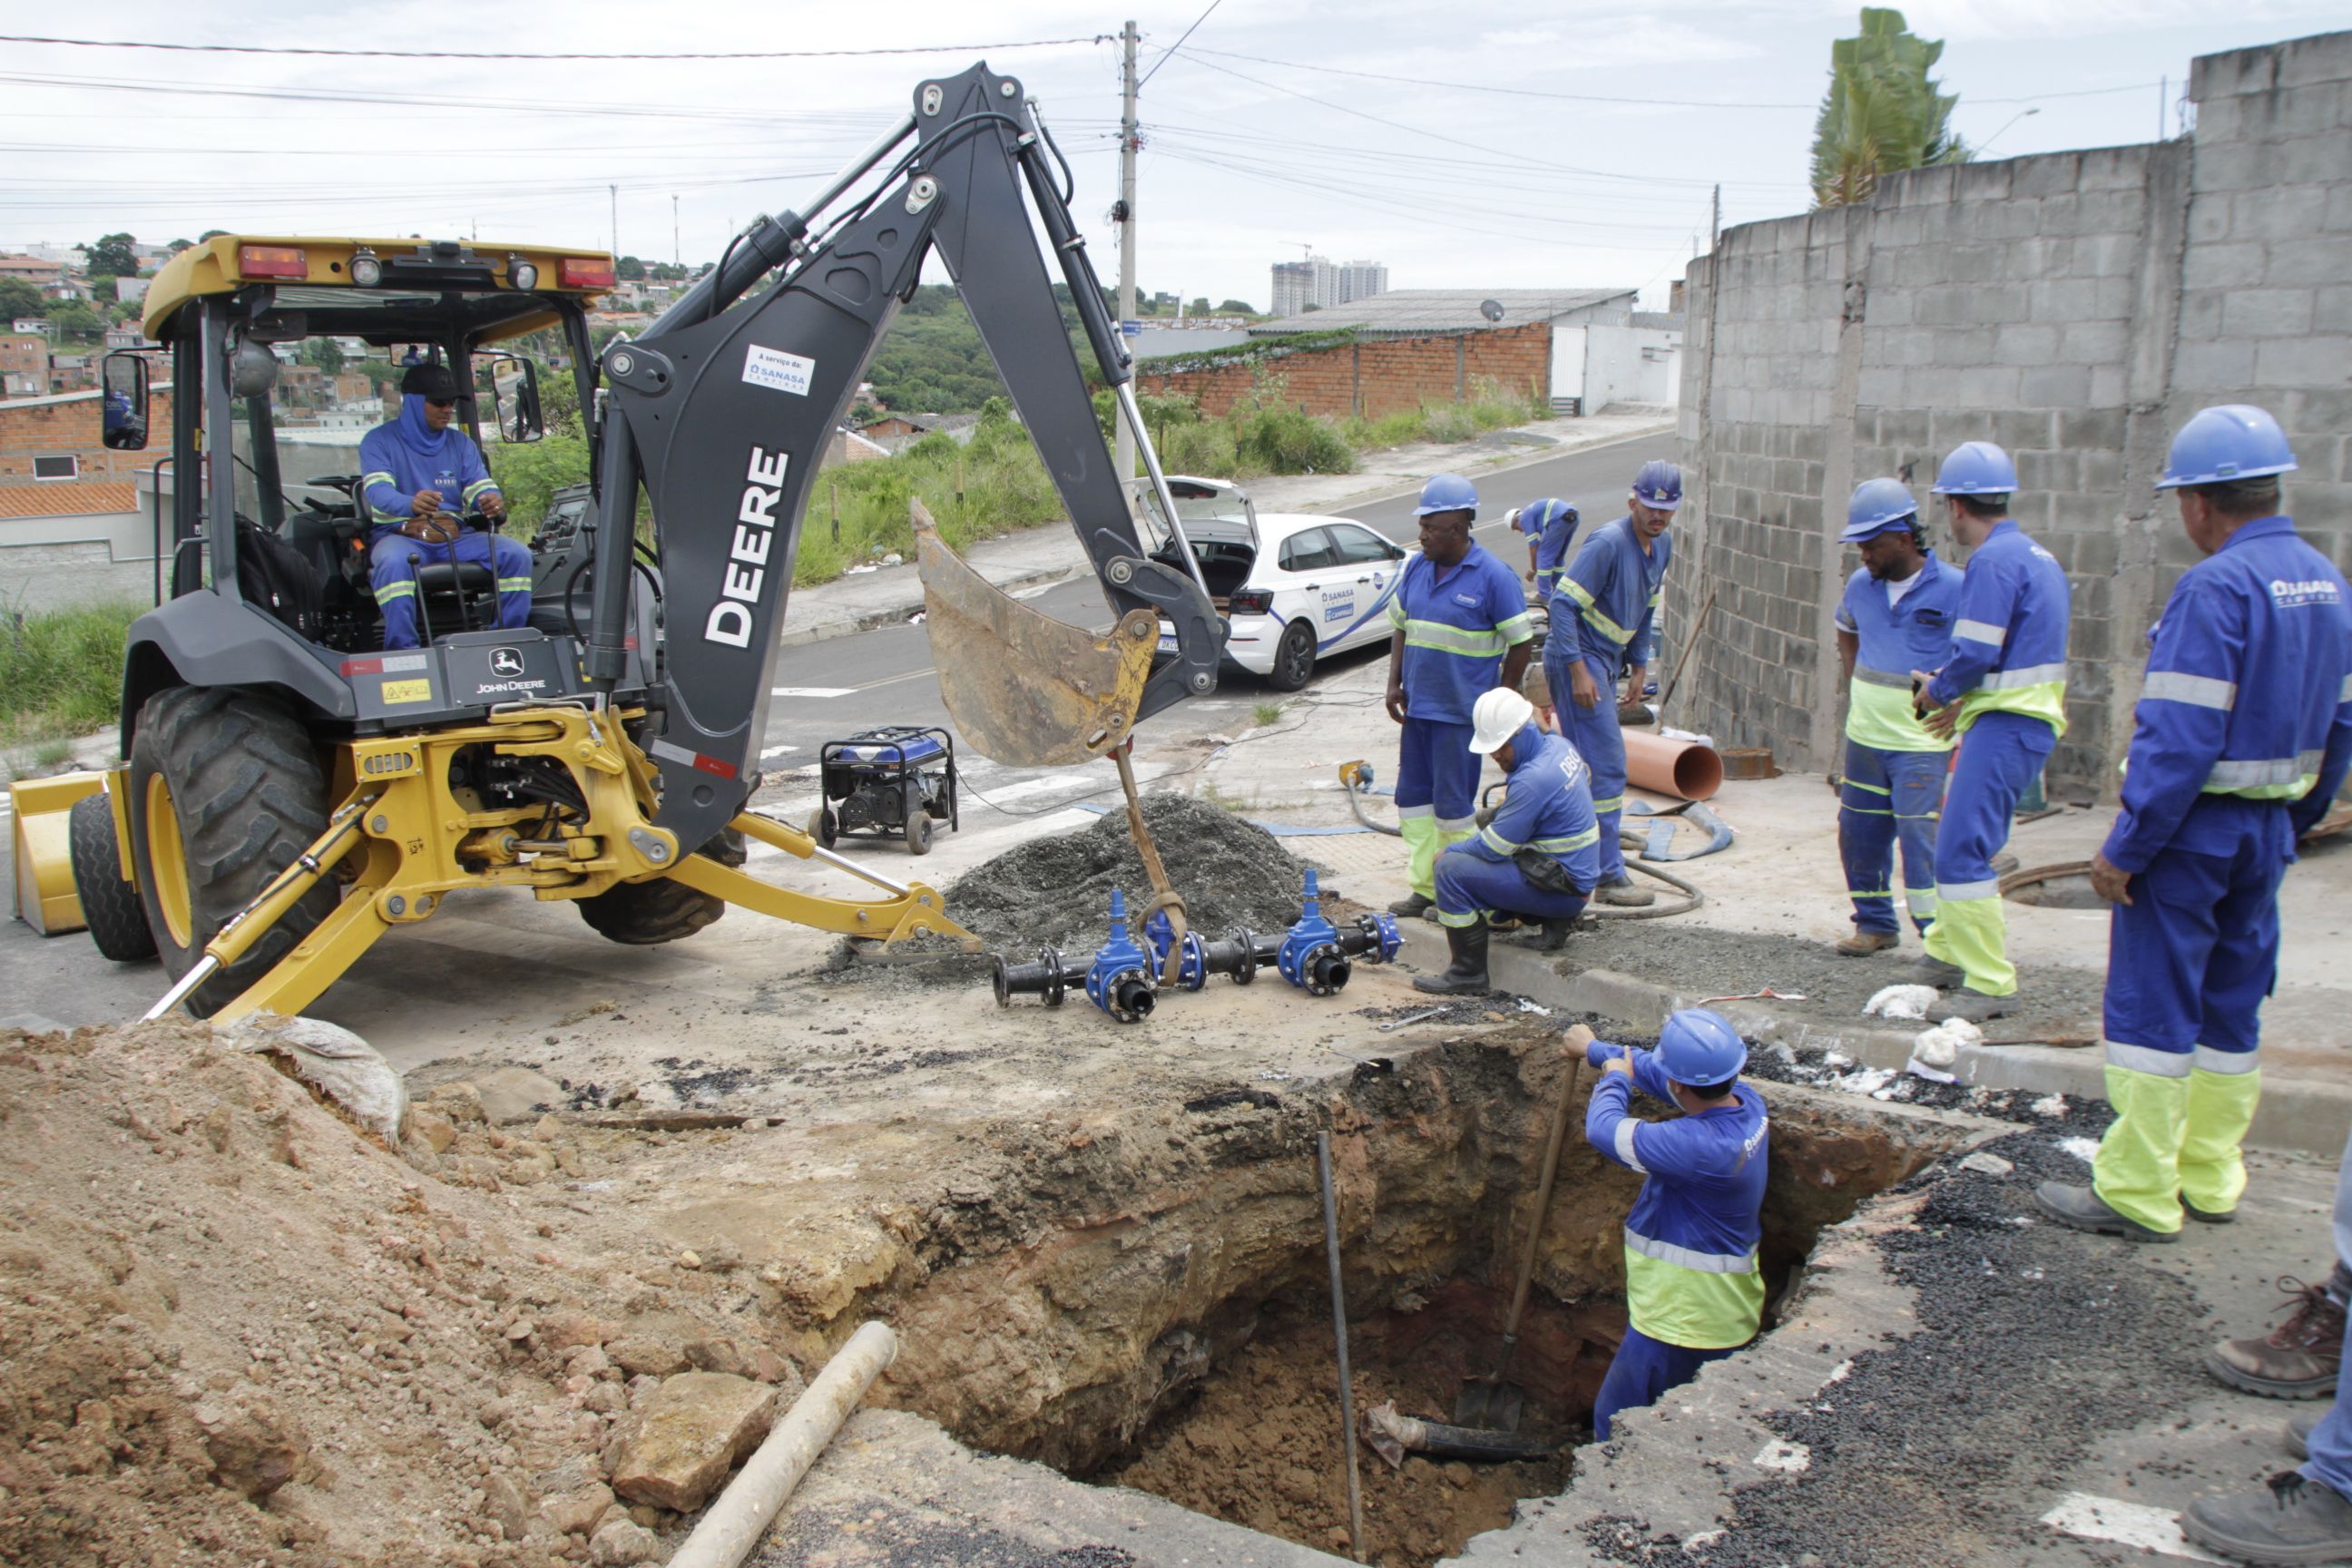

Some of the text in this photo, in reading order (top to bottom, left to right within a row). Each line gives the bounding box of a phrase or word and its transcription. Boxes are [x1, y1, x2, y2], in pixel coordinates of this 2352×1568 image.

[766, 356, 790, 367] serviço
[791, 361, 802, 369] da:
[760, 368, 805, 385] SANASA
[705, 446, 789, 648] DEERE
[1328, 589, 1354, 601] SANASA
[476, 680, 546, 694] JOHN DEERE
[1560, 748, 1581, 779] DBO
